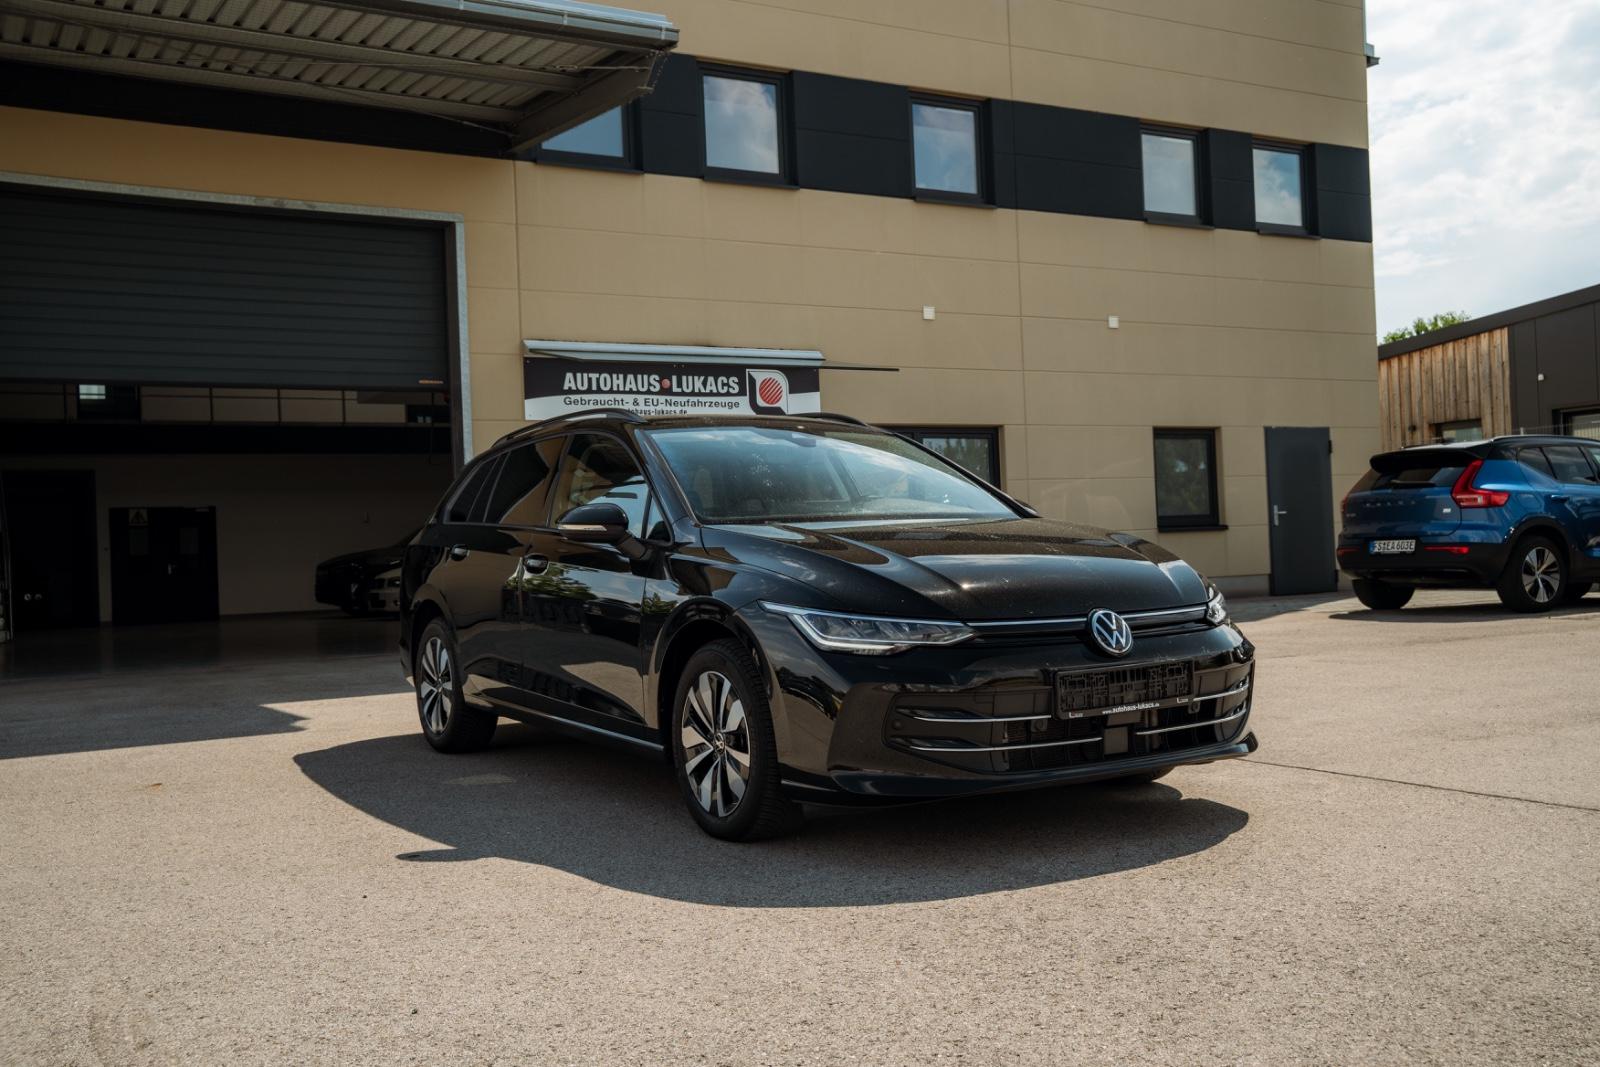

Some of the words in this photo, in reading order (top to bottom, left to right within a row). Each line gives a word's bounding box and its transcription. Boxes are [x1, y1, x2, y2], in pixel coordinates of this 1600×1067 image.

[563, 372, 661, 392] AUTOHAUS
[672, 375, 740, 394] LUKACS
[563, 396, 630, 407] Gebraucht-
[632, 398, 640, 407] &
[644, 398, 740, 409] EU-Neufahrzeuge
